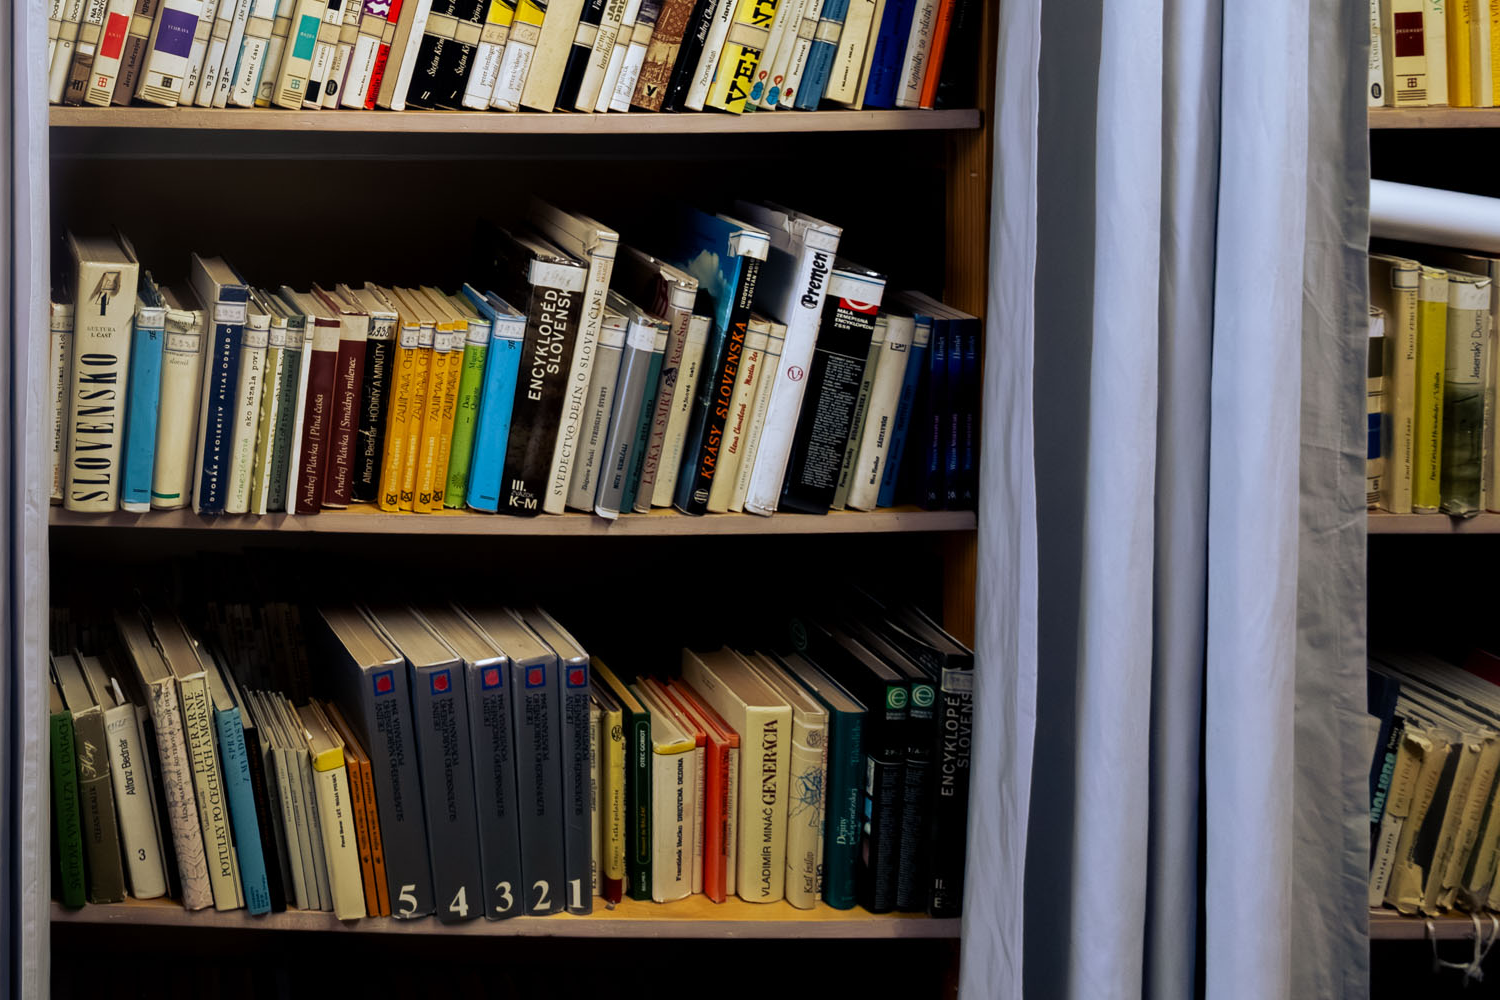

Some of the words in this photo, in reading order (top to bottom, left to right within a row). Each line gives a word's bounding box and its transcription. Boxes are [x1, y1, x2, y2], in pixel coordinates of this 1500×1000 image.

[547, 289, 572, 374] SLOVENSK
[580, 290, 603, 368] SLOVENČINE
[528, 291, 558, 400] ENCYKLOPÉD
[936, 337, 945, 360] Hamlet
[1470, 342, 1482, 378] Jesenský
[344, 357, 357, 389] milenec
[578, 373, 586, 381] O
[312, 394, 323, 412] čaša
[340, 391, 355, 427] Smädný
[567, 386, 584, 420] DEJÍN
[701, 425, 725, 479] KRÁSY
[715, 322, 747, 418] SLOVENSKA
[72, 353, 118, 501] SLOVENSKO
[309, 415, 321, 436] Plná
[306, 444, 319, 473] Plávka
[337, 435, 350, 464] Plávka
[553, 425, 576, 495] SVEDECTVO
[304, 475, 317, 506] Andrej
[334, 466, 347, 496] Andrej
[194, 689, 210, 737] MORAVE
[185, 693, 206, 773] LITERÁRNE
[75, 741, 96, 777] Hry
[119, 739, 130, 769] Bednár
[762, 719, 778, 805] GENERÁCIA
[122, 771, 136, 795] Alfonz
[204, 750, 220, 804] ČECHÁCH
[212, 806, 221, 821] PO
[762, 808, 772, 842] MINÁČ
[837, 817, 847, 845] Dejiny
[138, 849, 146, 861] 3
[215, 824, 231, 877] POTULKY
[761, 846, 771, 897] VLADIMÍR
[399, 884, 417, 914] 5
[449, 886, 469, 916] 4
[495, 881, 513, 912] 3
[532, 880, 551, 910] 2
[568, 879, 584, 908] 1
